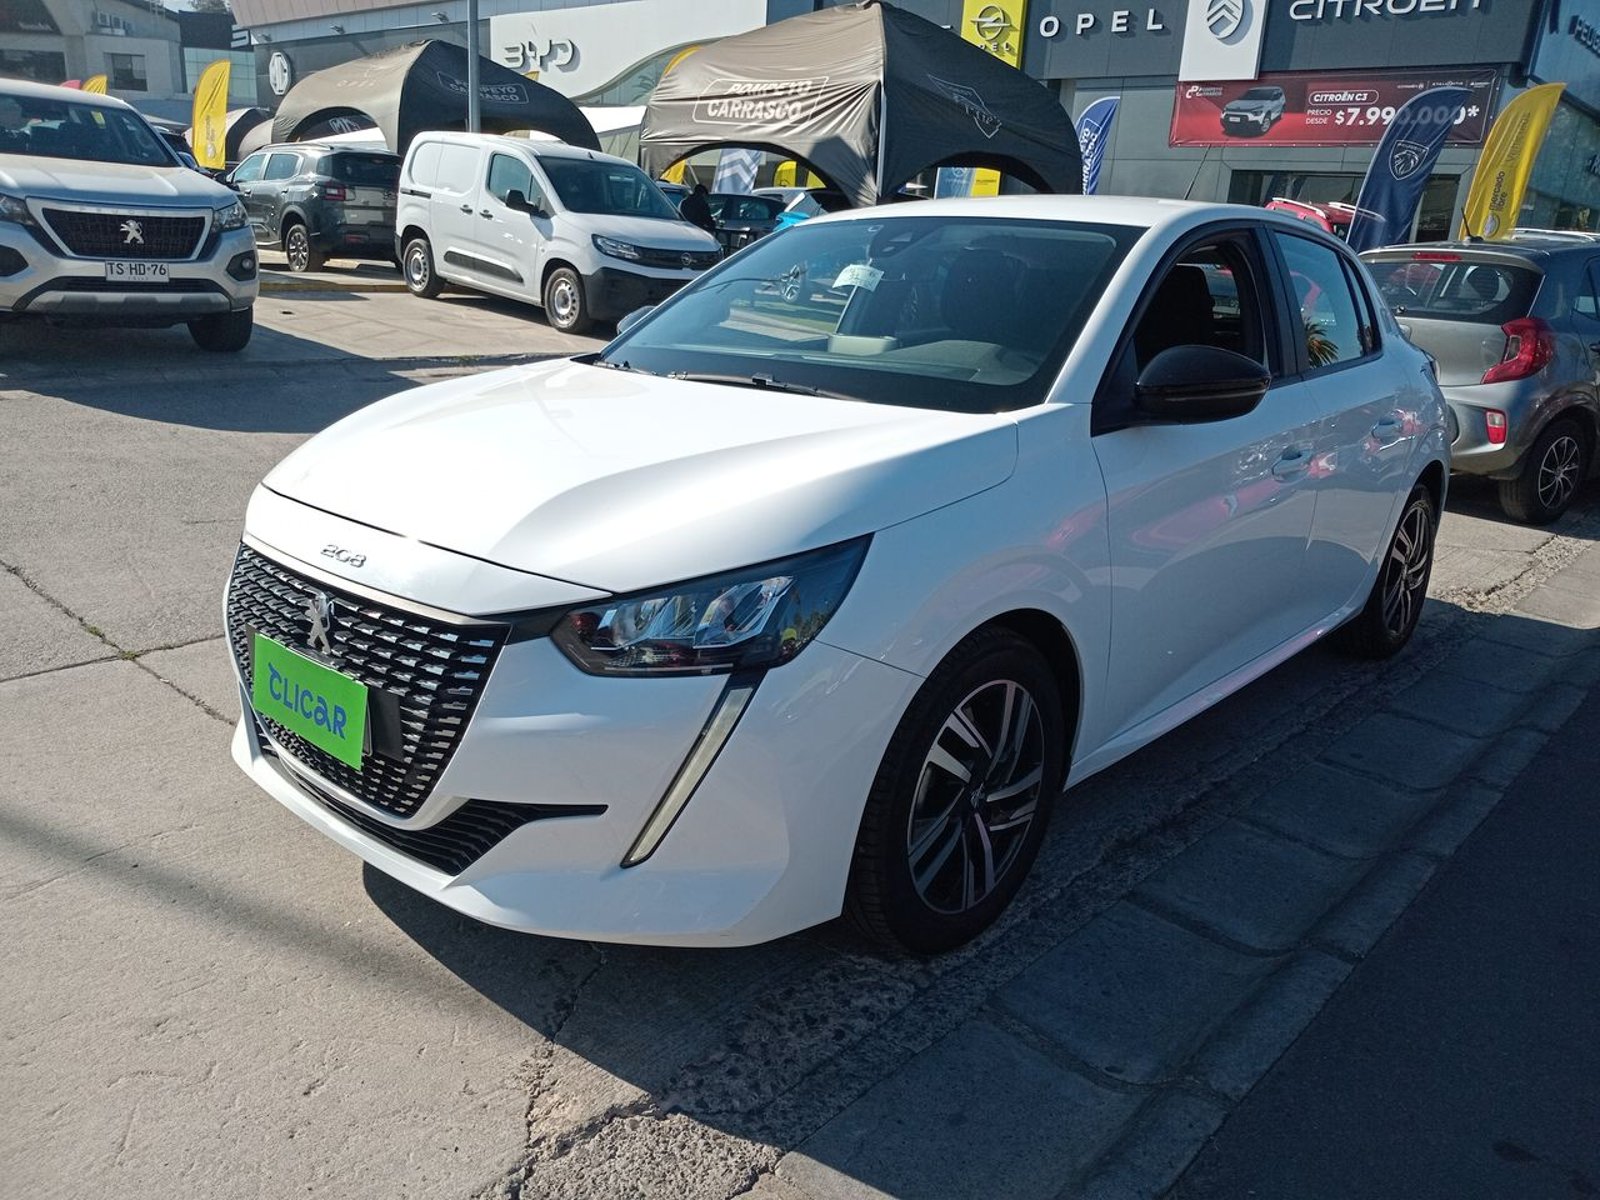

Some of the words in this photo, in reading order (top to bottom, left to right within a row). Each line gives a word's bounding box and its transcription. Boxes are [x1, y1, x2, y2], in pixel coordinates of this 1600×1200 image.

[1039, 8, 1163, 38] OPEL
[503, 38, 574, 68] BYD
[977, 42, 1010, 52] PEL
[1313, 91, 1355, 102] CITROËN
[1355, 93, 1369, 102] C3
[707, 99, 802, 120] CARRASCO
[1305, 117, 1328, 125] DESDE
[107, 263, 124, 275] TS
[150, 264, 167, 276] 76
[320, 544, 367, 568] 208
